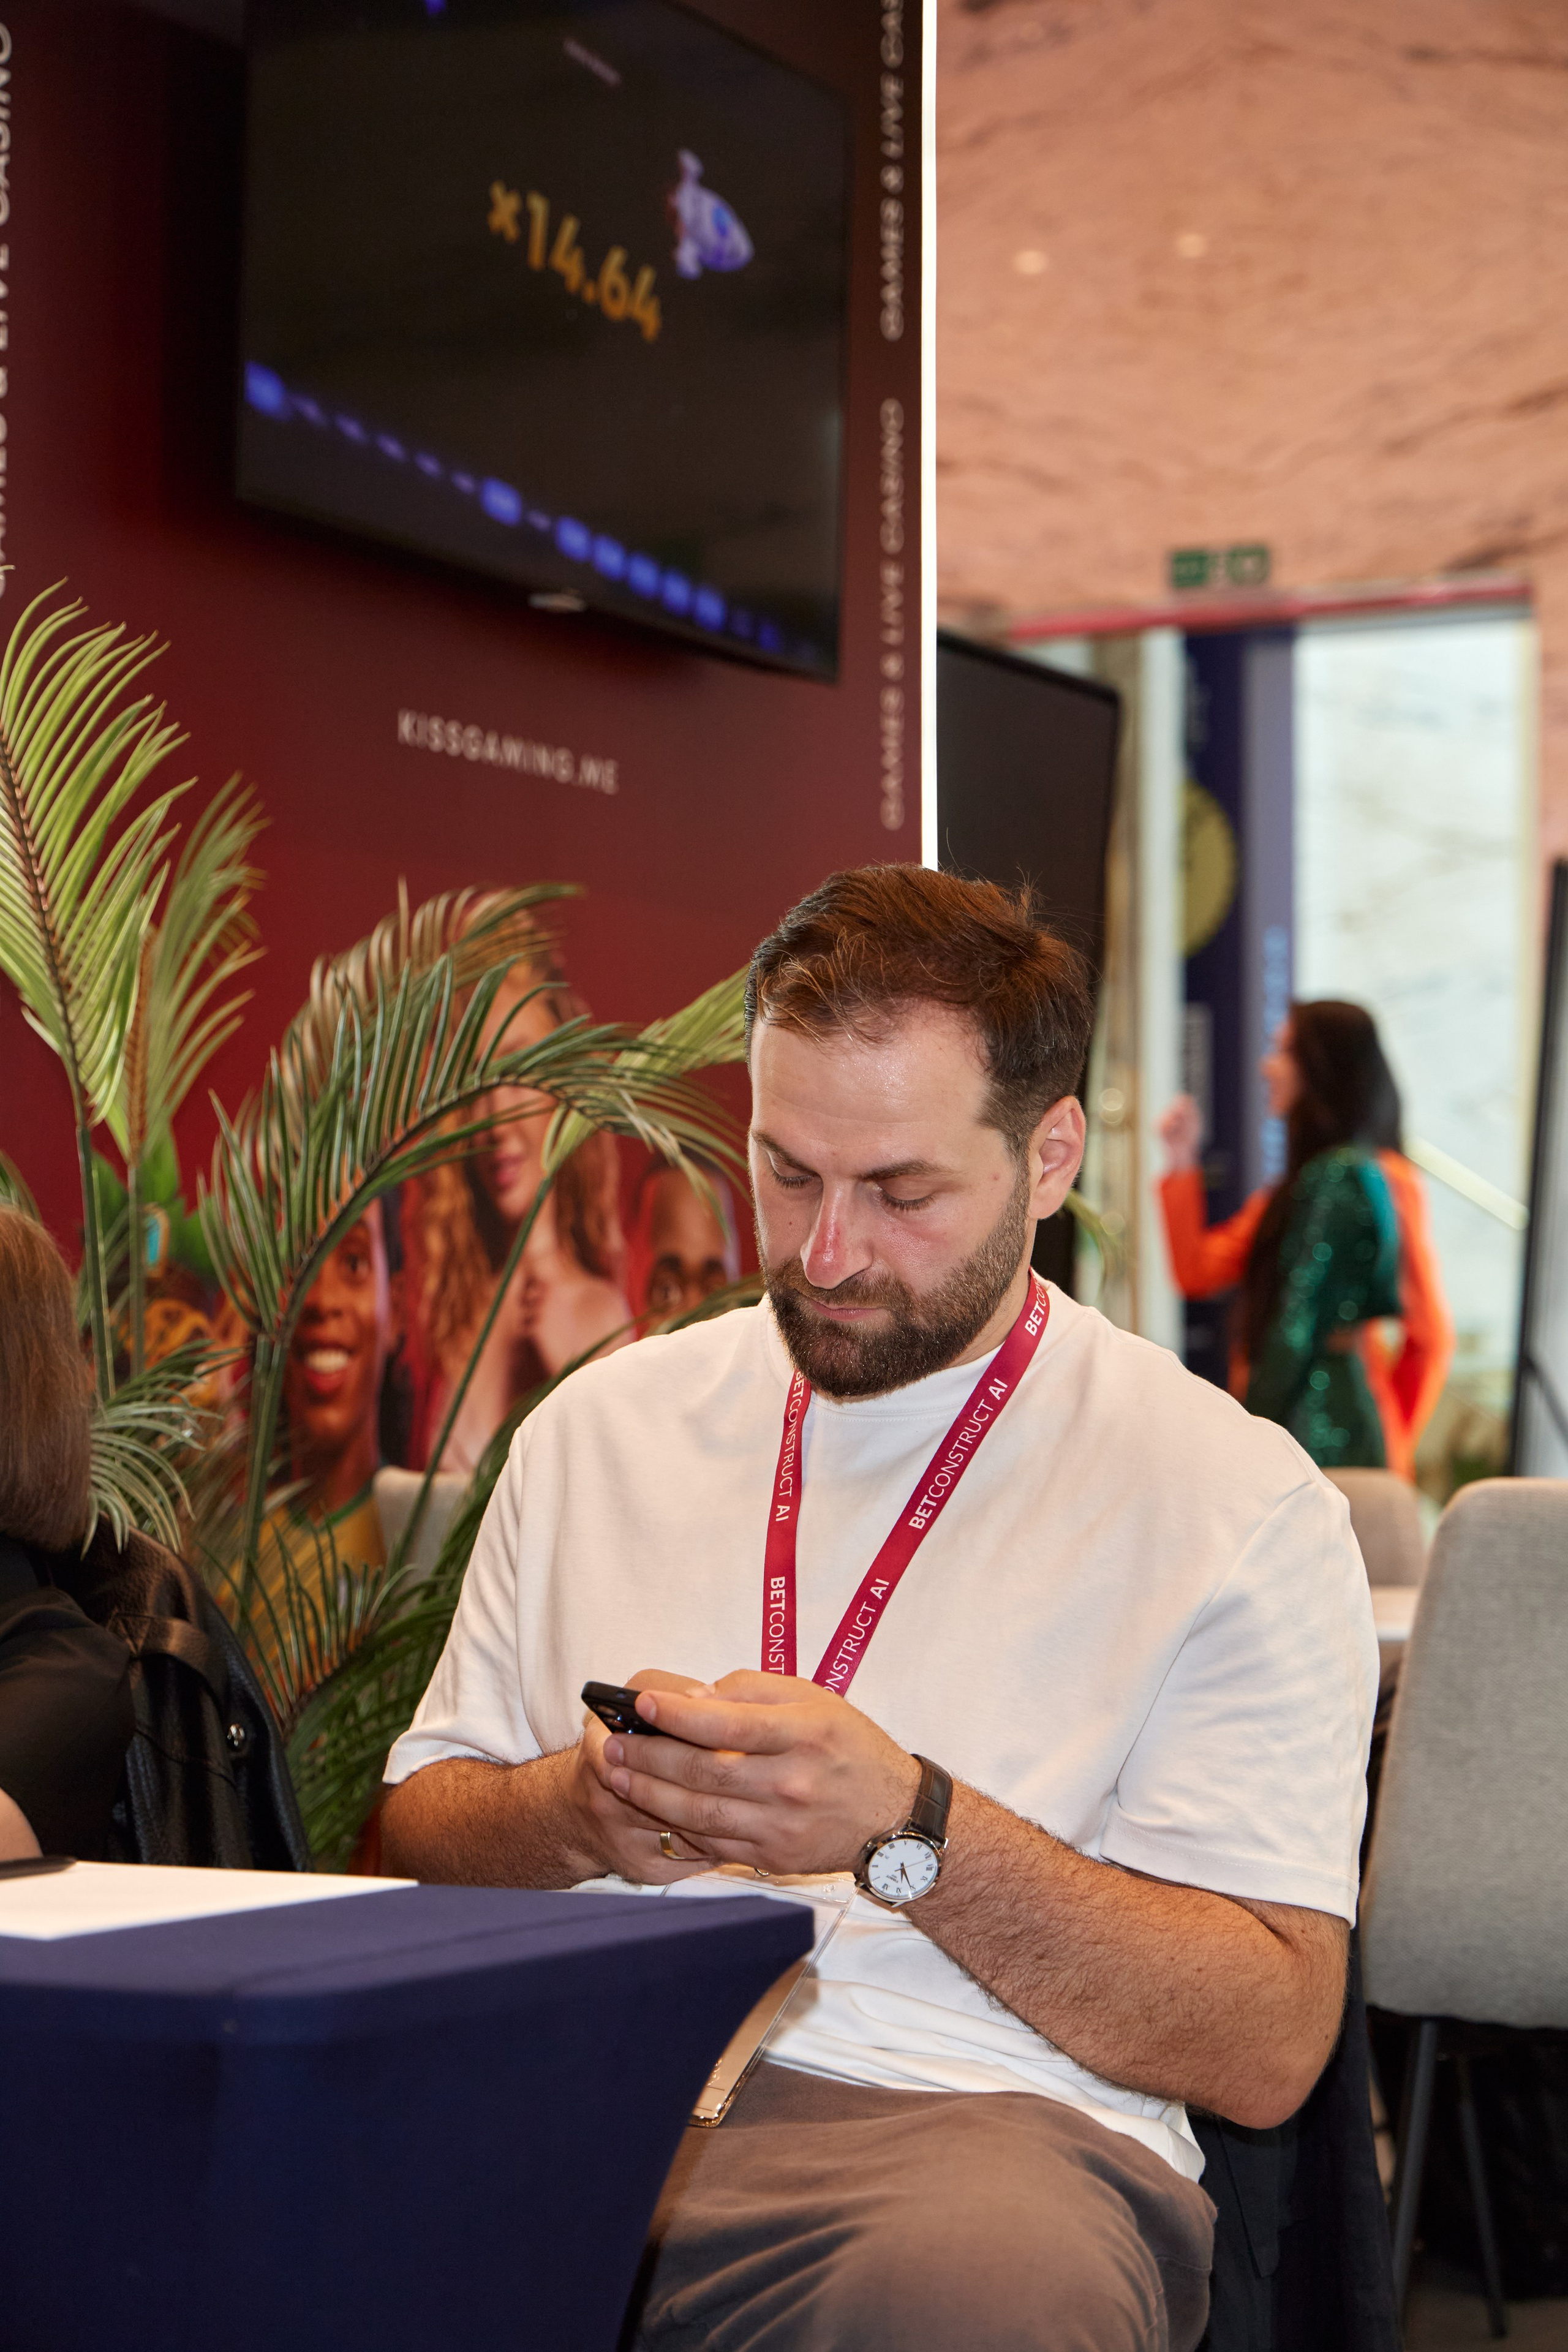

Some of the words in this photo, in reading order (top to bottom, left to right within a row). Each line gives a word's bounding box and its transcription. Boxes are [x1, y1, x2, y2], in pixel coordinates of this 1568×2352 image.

[398, 709, 618, 795] KISSGAMING.ME
[908, 1398, 993, 1529] BETCONSTRUCT
[989, 1378, 1008, 1400] AI
[775, 1505, 790, 1521] AI
[870, 1578, 890, 1600] AI
